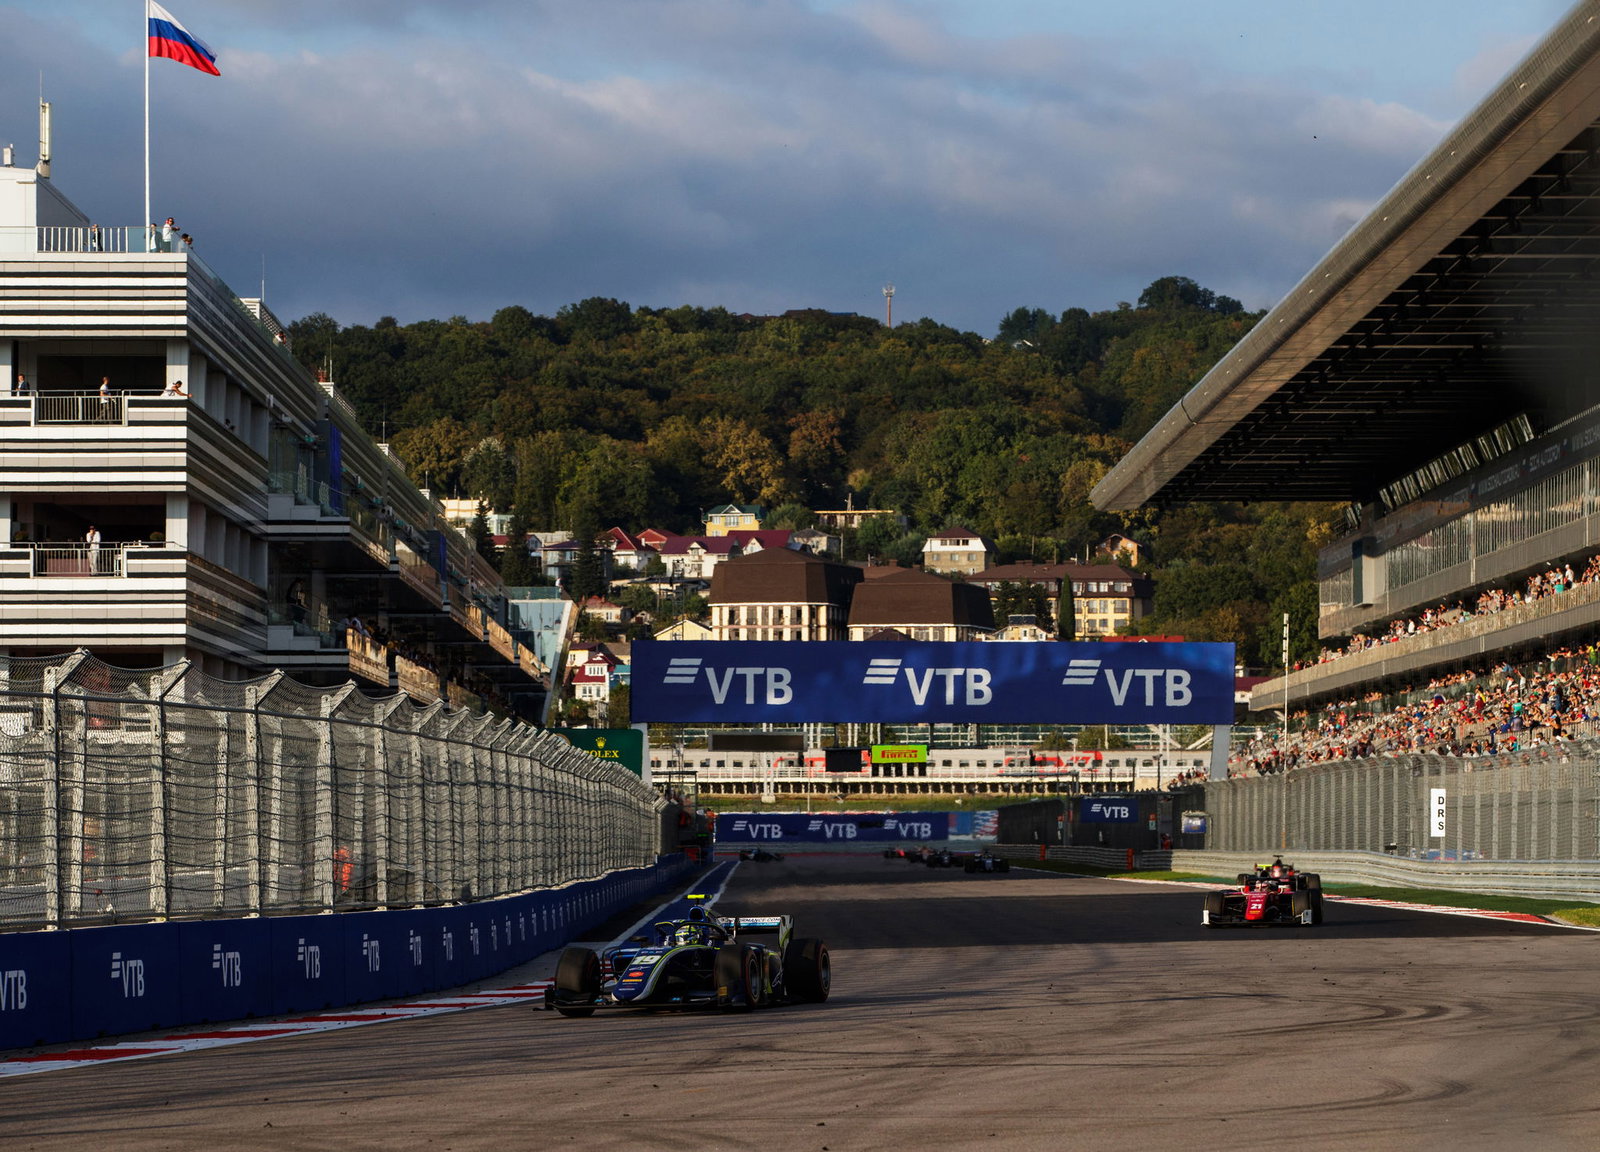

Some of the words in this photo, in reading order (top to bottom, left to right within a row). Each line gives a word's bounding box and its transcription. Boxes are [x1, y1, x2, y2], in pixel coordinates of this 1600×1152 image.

[705, 667, 793, 706] VTB
[904, 667, 993, 706] VTB
[1104, 668, 1193, 707] VTB
[899, 822, 931, 838] VTB
[1103, 806, 1129, 819] VTB
[1437, 796, 1445, 831] DRS
[749, 824, 783, 839] VTB
[825, 823, 857, 838] VTB
[221, 951, 242, 988] VTB
[304, 945, 321, 979] VTB
[632, 956, 661, 965] 19
[0, 969, 27, 1011] VTB
[121, 959, 145, 998] VTB
